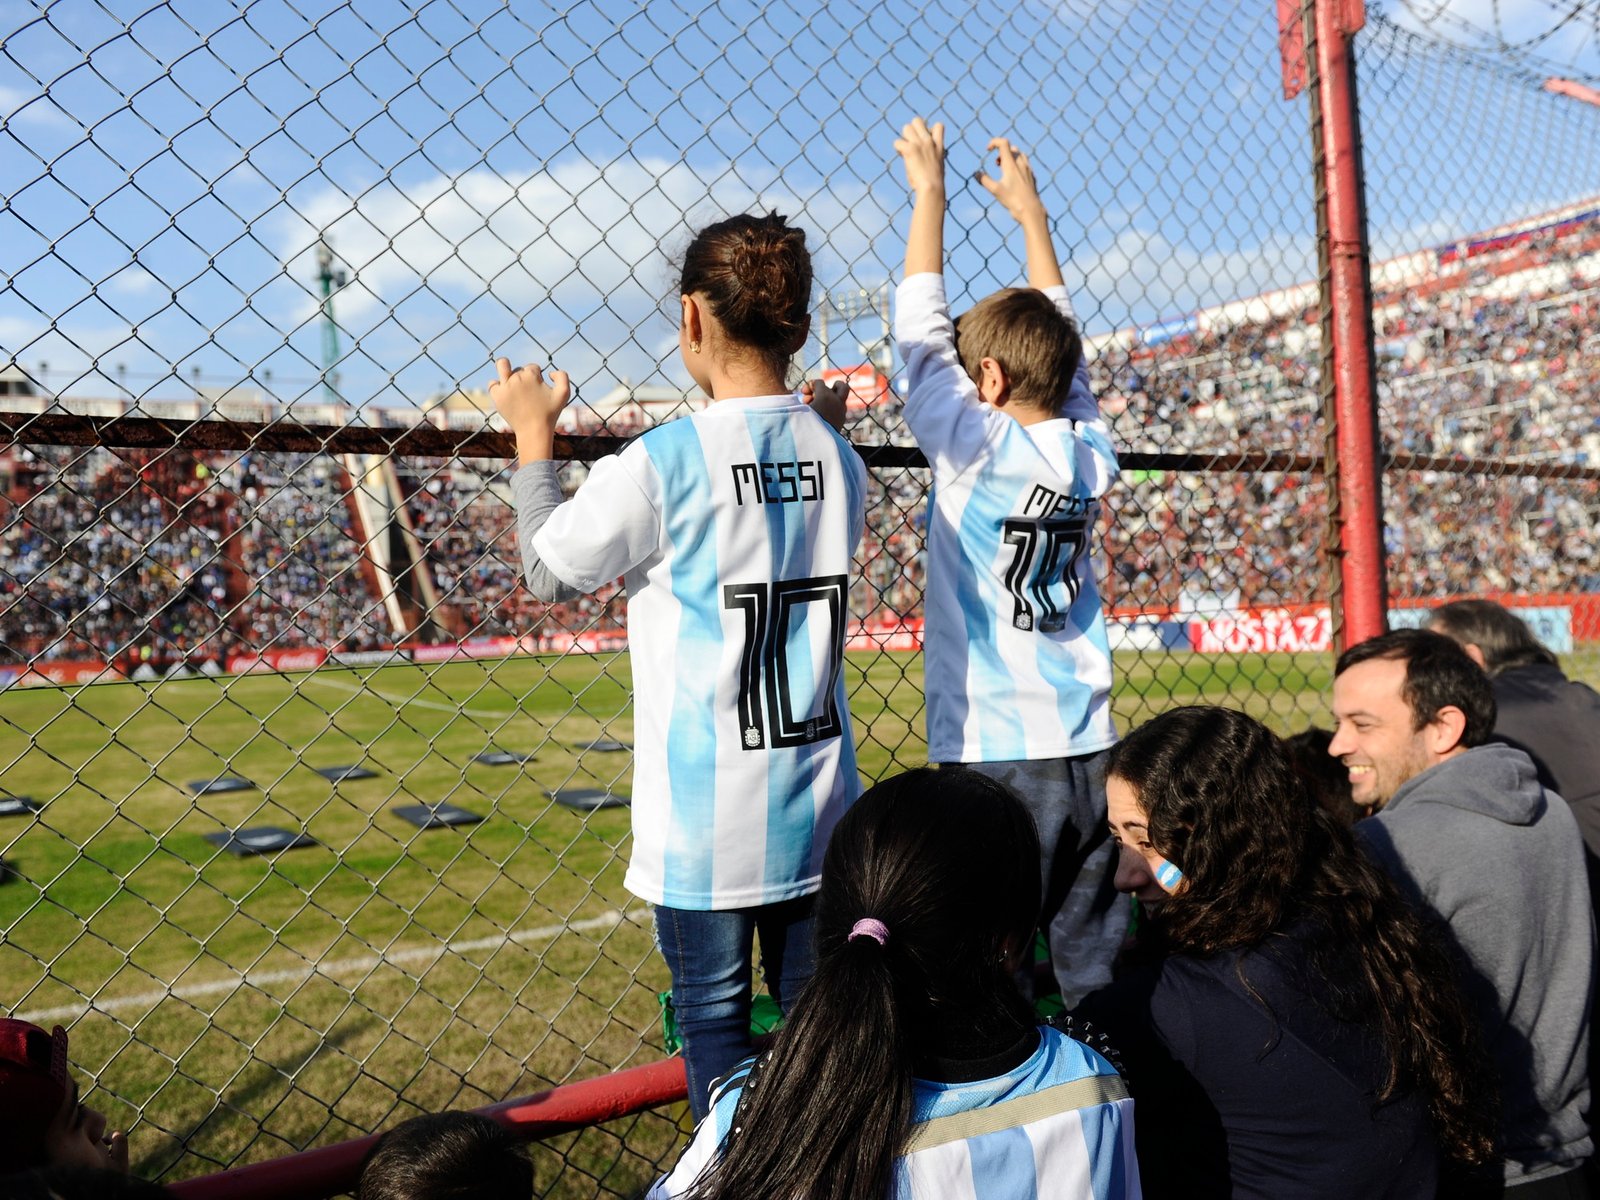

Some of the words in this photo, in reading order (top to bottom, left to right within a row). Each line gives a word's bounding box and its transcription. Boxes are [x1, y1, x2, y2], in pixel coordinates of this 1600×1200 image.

[731, 460, 825, 506] MESSI
[1003, 519, 1087, 633] 10
[723, 574, 848, 751] 10
